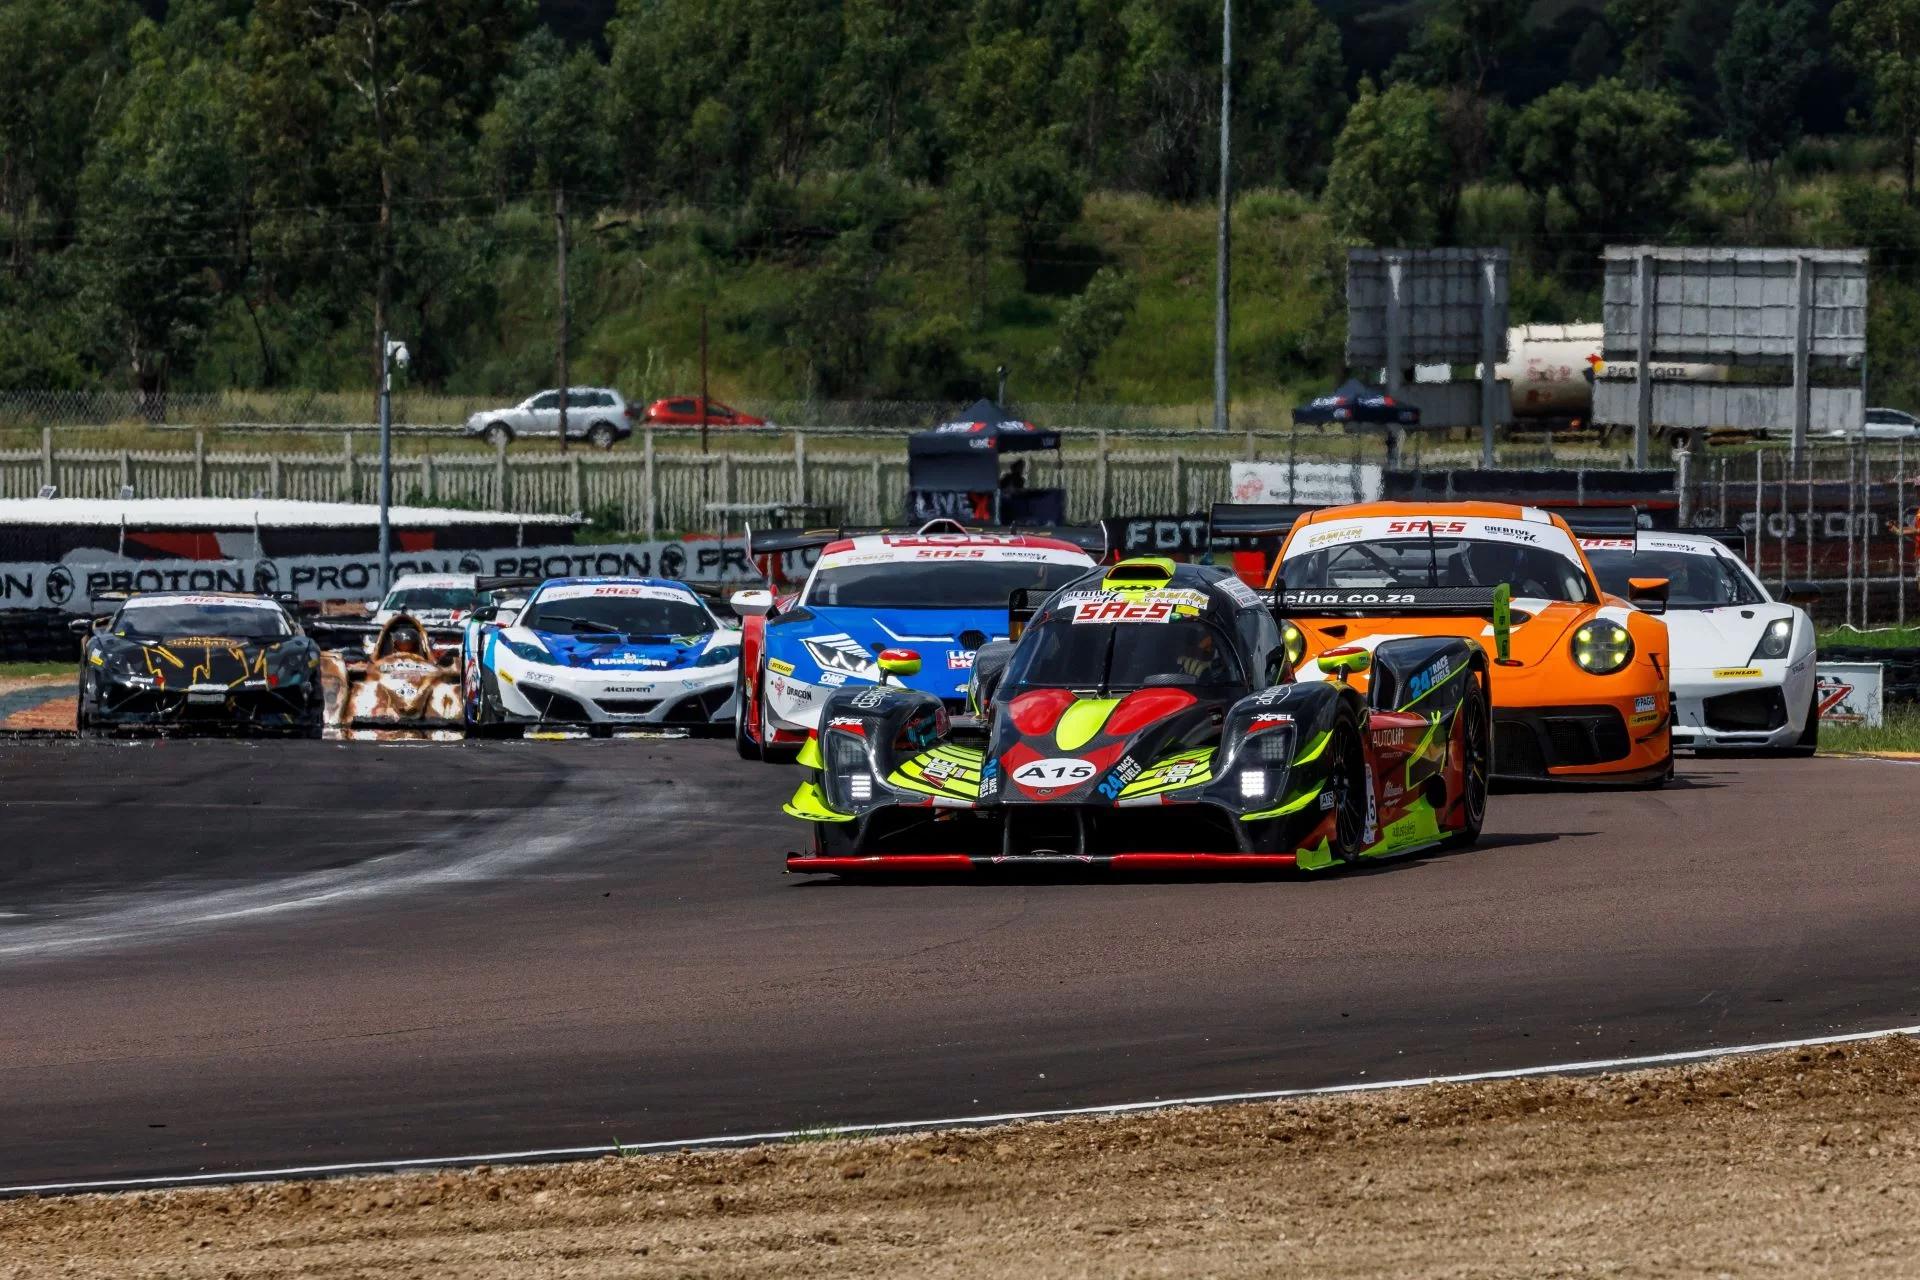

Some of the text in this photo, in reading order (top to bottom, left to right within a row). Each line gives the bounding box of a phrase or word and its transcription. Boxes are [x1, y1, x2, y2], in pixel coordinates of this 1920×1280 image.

[916, 550, 985, 558] SAES
[494, 551, 650, 578] PROTON
[1144, 591, 1209, 605] SAMLIN
[1075, 602, 1174, 620] SAES
[1432, 654, 1449, 675] RACE
[1431, 666, 1450, 688] FUELS
[603, 686, 651, 694] McLaren
[786, 686, 812, 701] DRAGON
[831, 716, 863, 727] XPEL
[1256, 713, 1295, 722] XPEL
[1117, 754, 1136, 774] RACE
[1017, 766, 1093, 779] A15
[1121, 762, 1143, 785] FUELS
